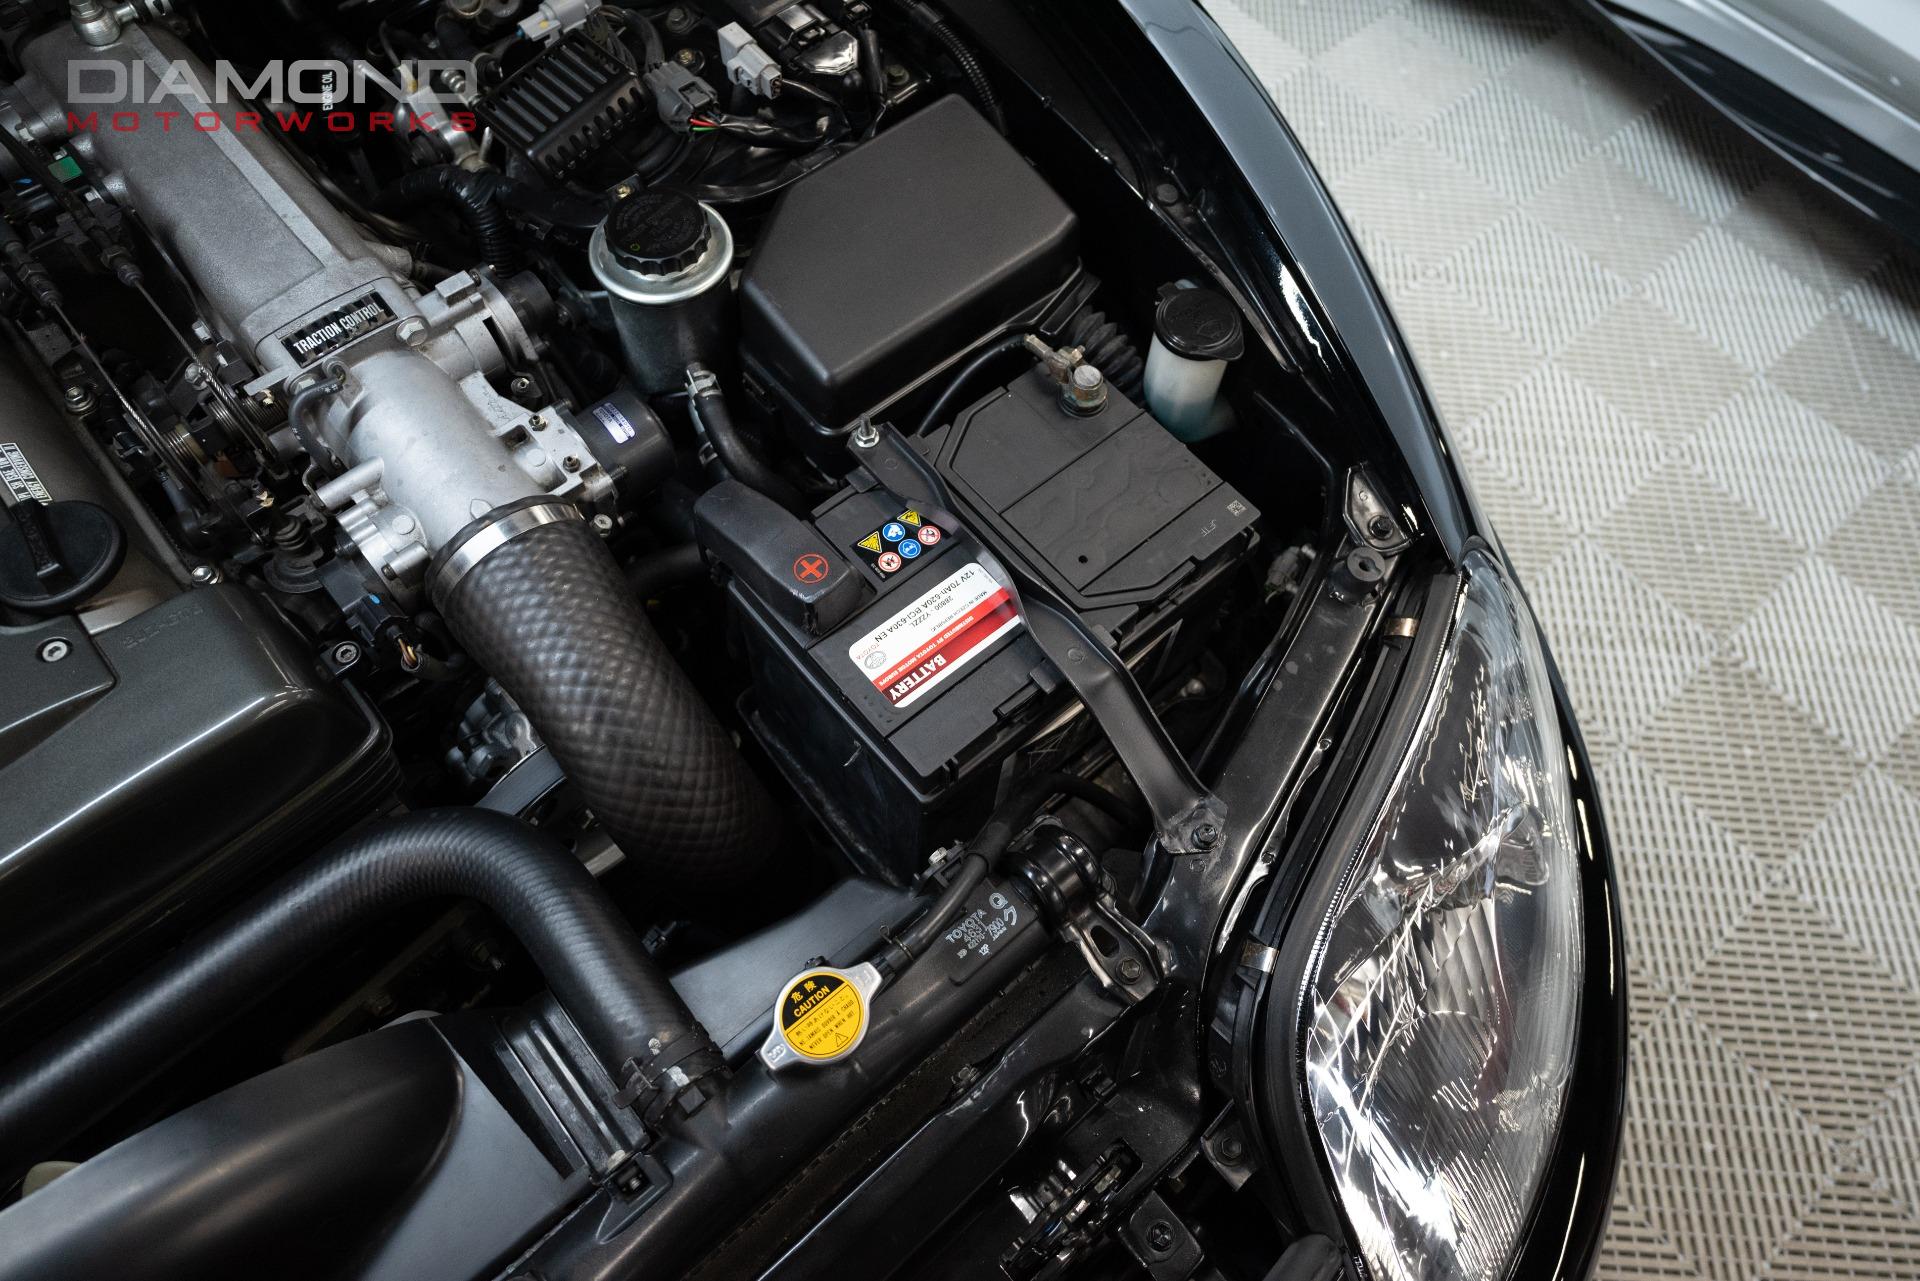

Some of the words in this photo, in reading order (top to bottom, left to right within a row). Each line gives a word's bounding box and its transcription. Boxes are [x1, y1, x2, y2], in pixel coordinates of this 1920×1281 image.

[321, 71, 333, 84] OIL
[293, 321, 342, 354] TRACTION
[339, 302, 385, 330] CONTROL
[960, 569, 975, 583] 12V
[874, 632, 888, 643] EN
[855, 642, 880, 661] TOYOTA
[916, 642, 937, 660] TOYOTA
[899, 658, 917, 673] MOTOR
[889, 653, 948, 701] BATTERY
[945, 908, 988, 943] TOYOTA
[793, 985, 831, 1018] CAUTION
[822, 1028, 834, 1040] OPEN
